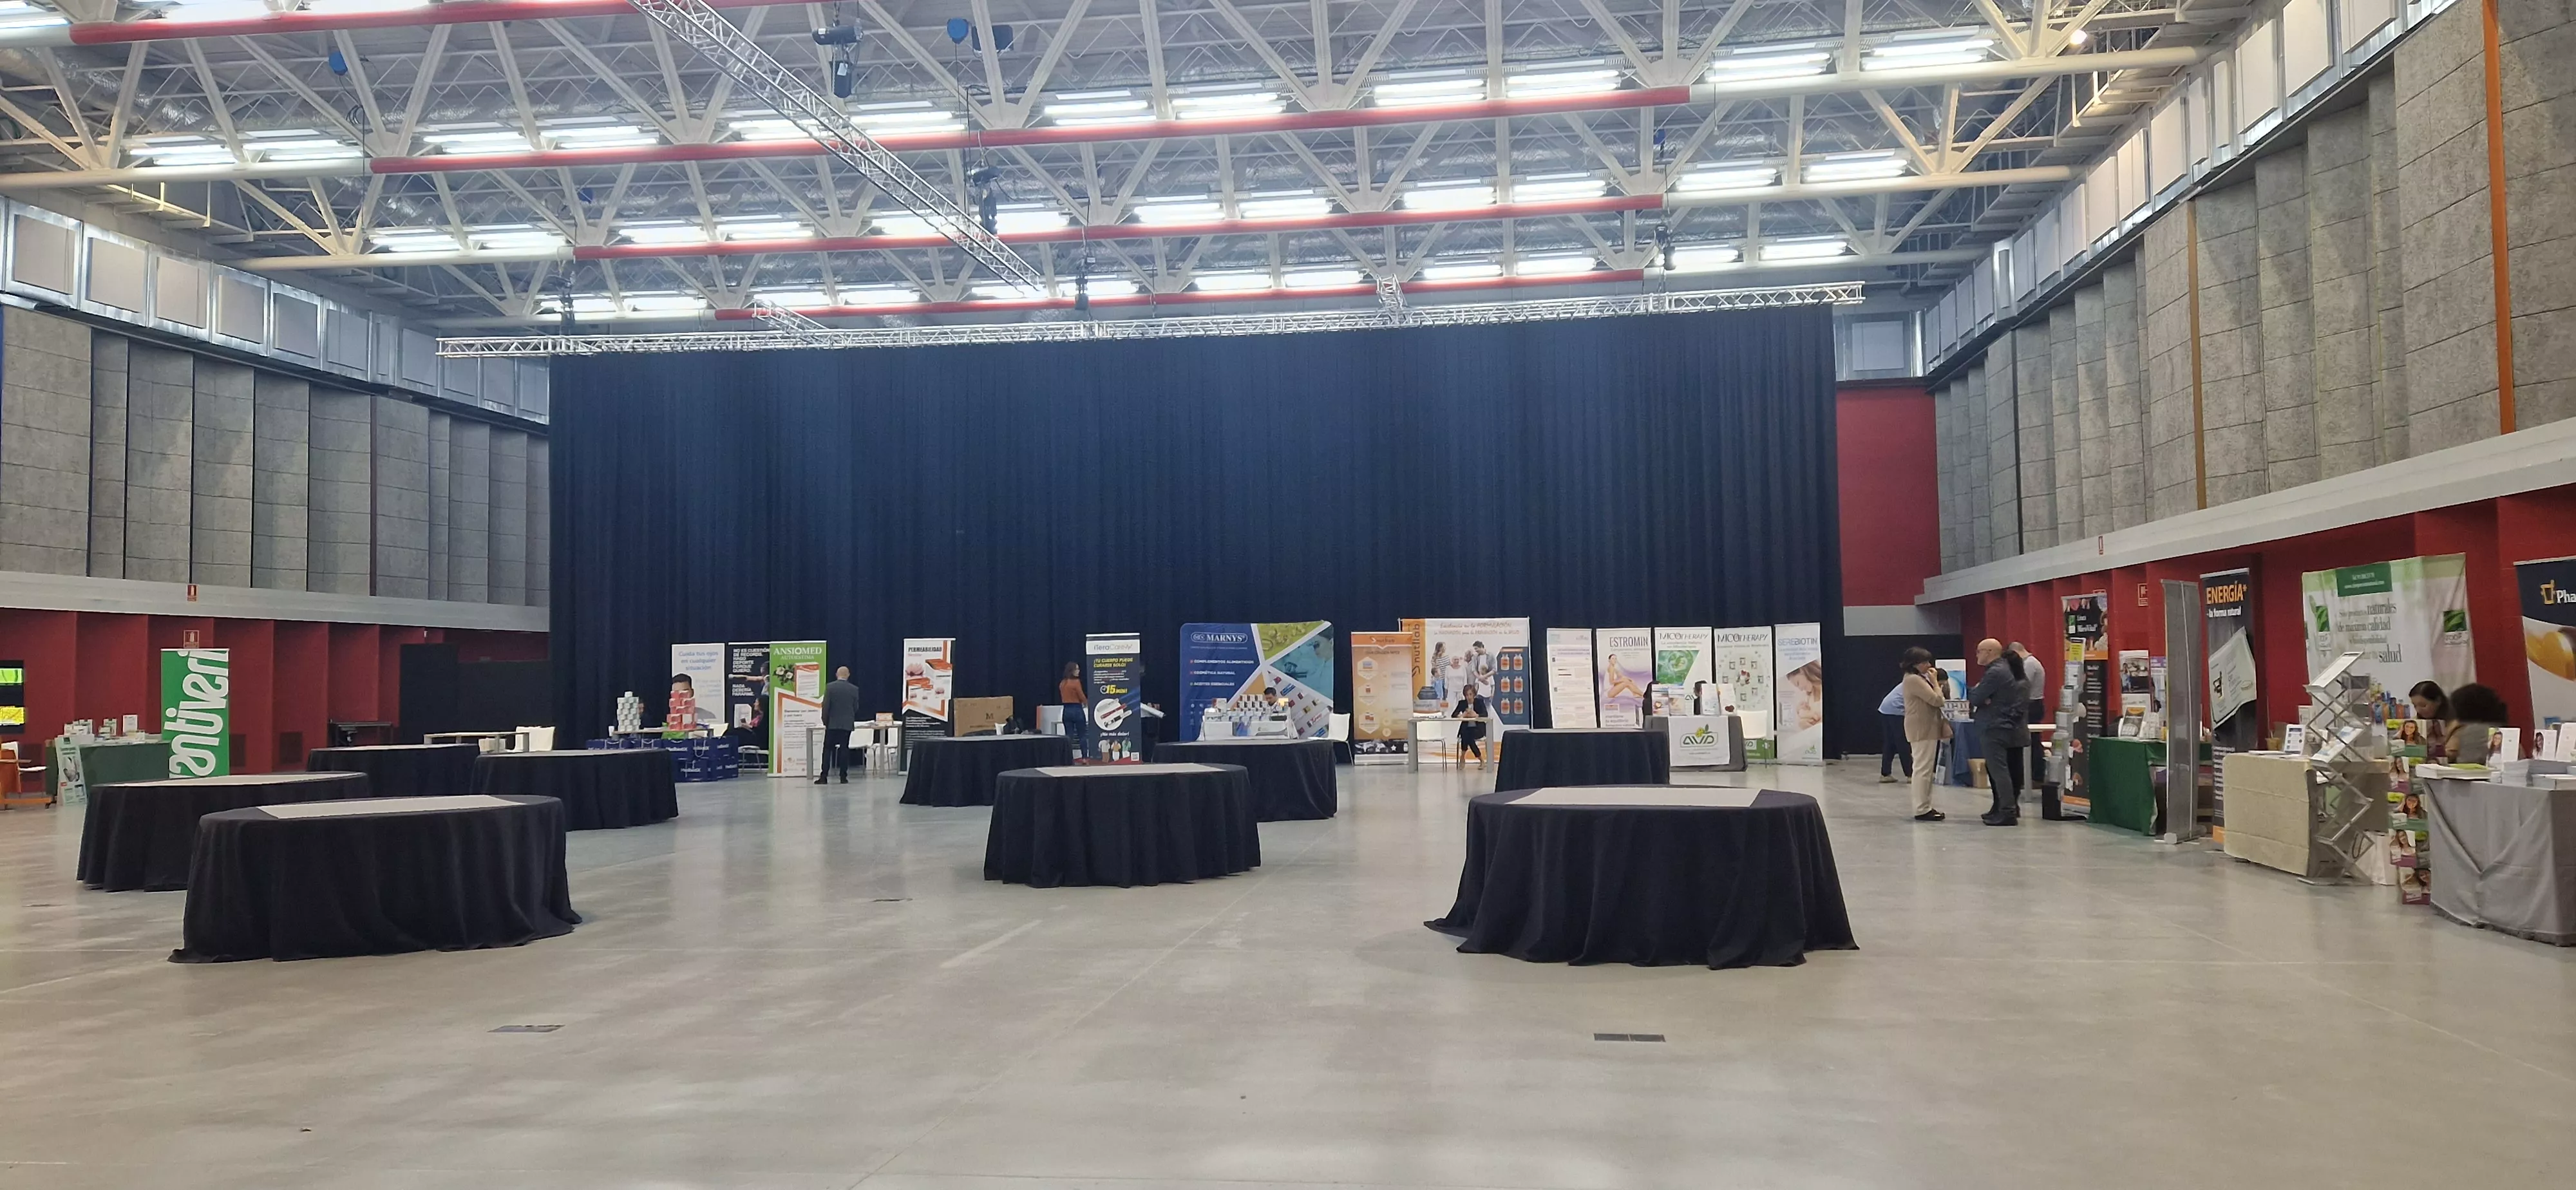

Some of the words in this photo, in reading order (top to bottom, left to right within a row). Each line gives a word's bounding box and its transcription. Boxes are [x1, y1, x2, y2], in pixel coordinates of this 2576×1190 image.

[2367, 598, 2397, 615] naturales
[2367, 616, 2391, 631] calidad
[1609, 636, 1649, 647] ESTROMIN
[2378, 643, 2402, 663] salud
[1107, 685, 1116, 694] 15
[164, 650, 229, 779] antiveri
